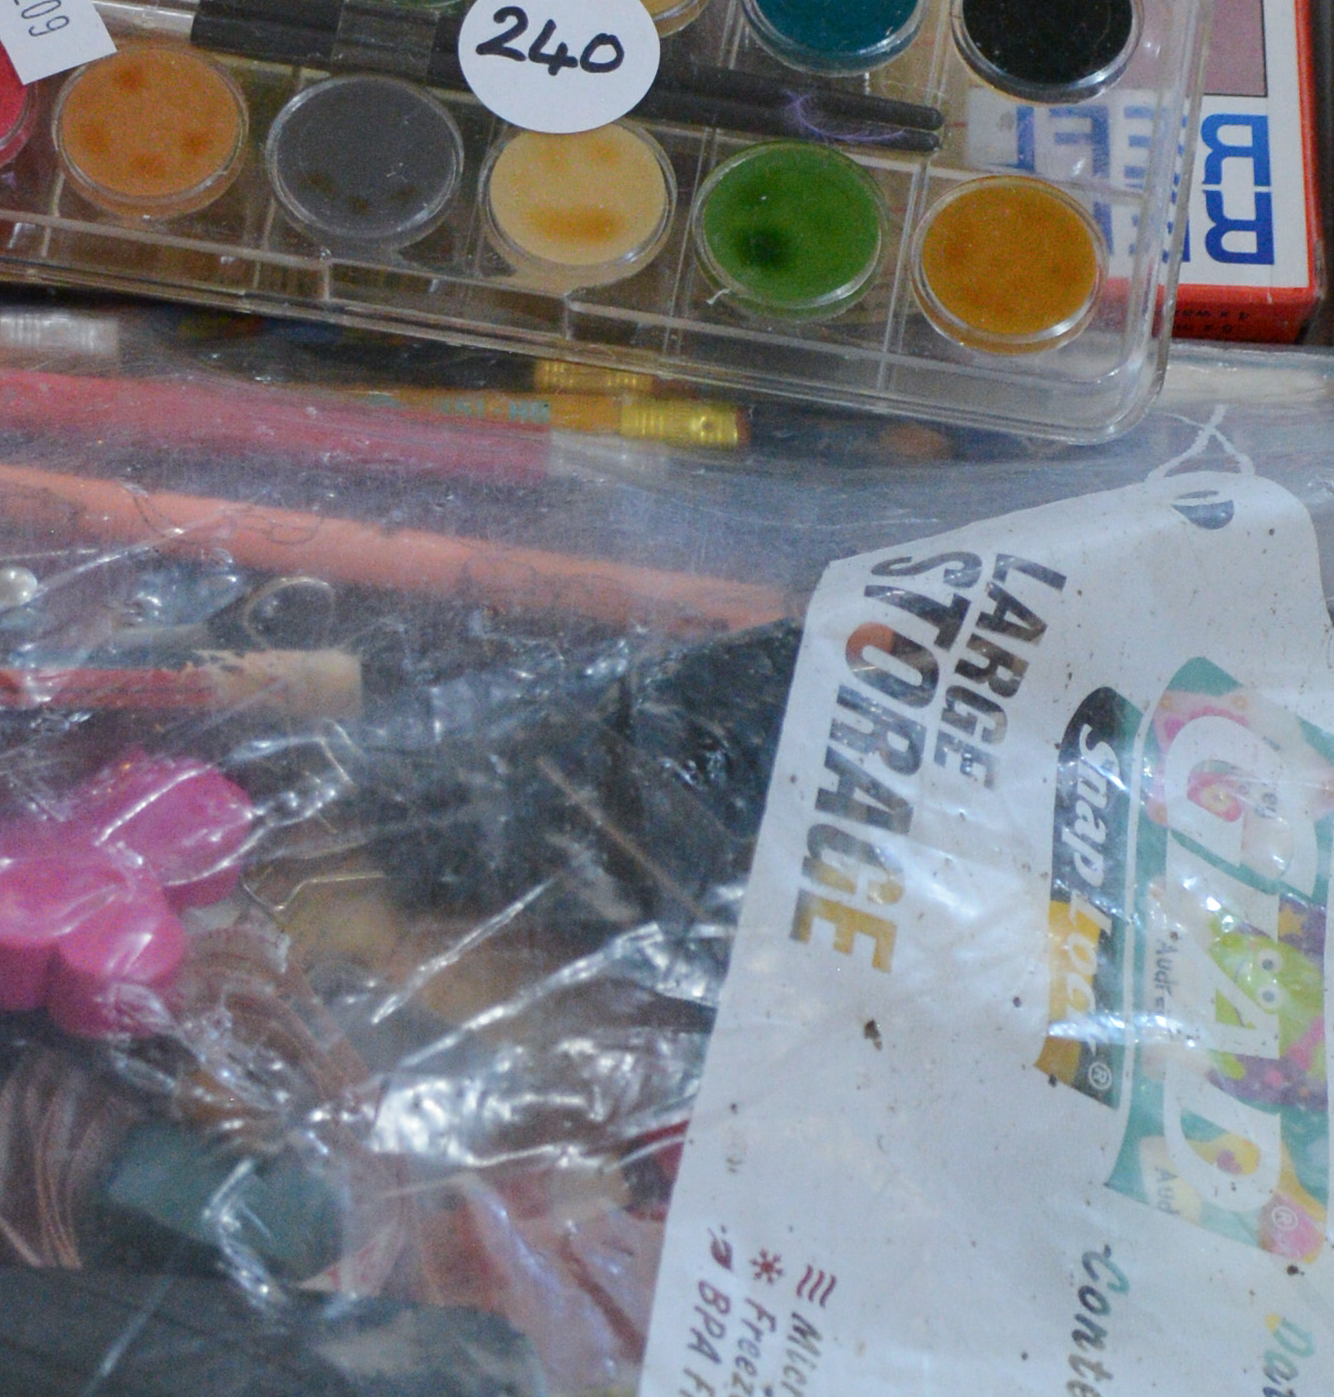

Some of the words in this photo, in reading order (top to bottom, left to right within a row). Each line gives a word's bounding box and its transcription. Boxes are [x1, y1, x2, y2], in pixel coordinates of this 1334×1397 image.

[476, 6, 625, 76] 240
[934, 552, 1067, 790] LARGE
[788, 550, 983, 973] STORAGE
[1058, 724, 1120, 887] Snap
[685, 1279, 732, 1366] BPA
